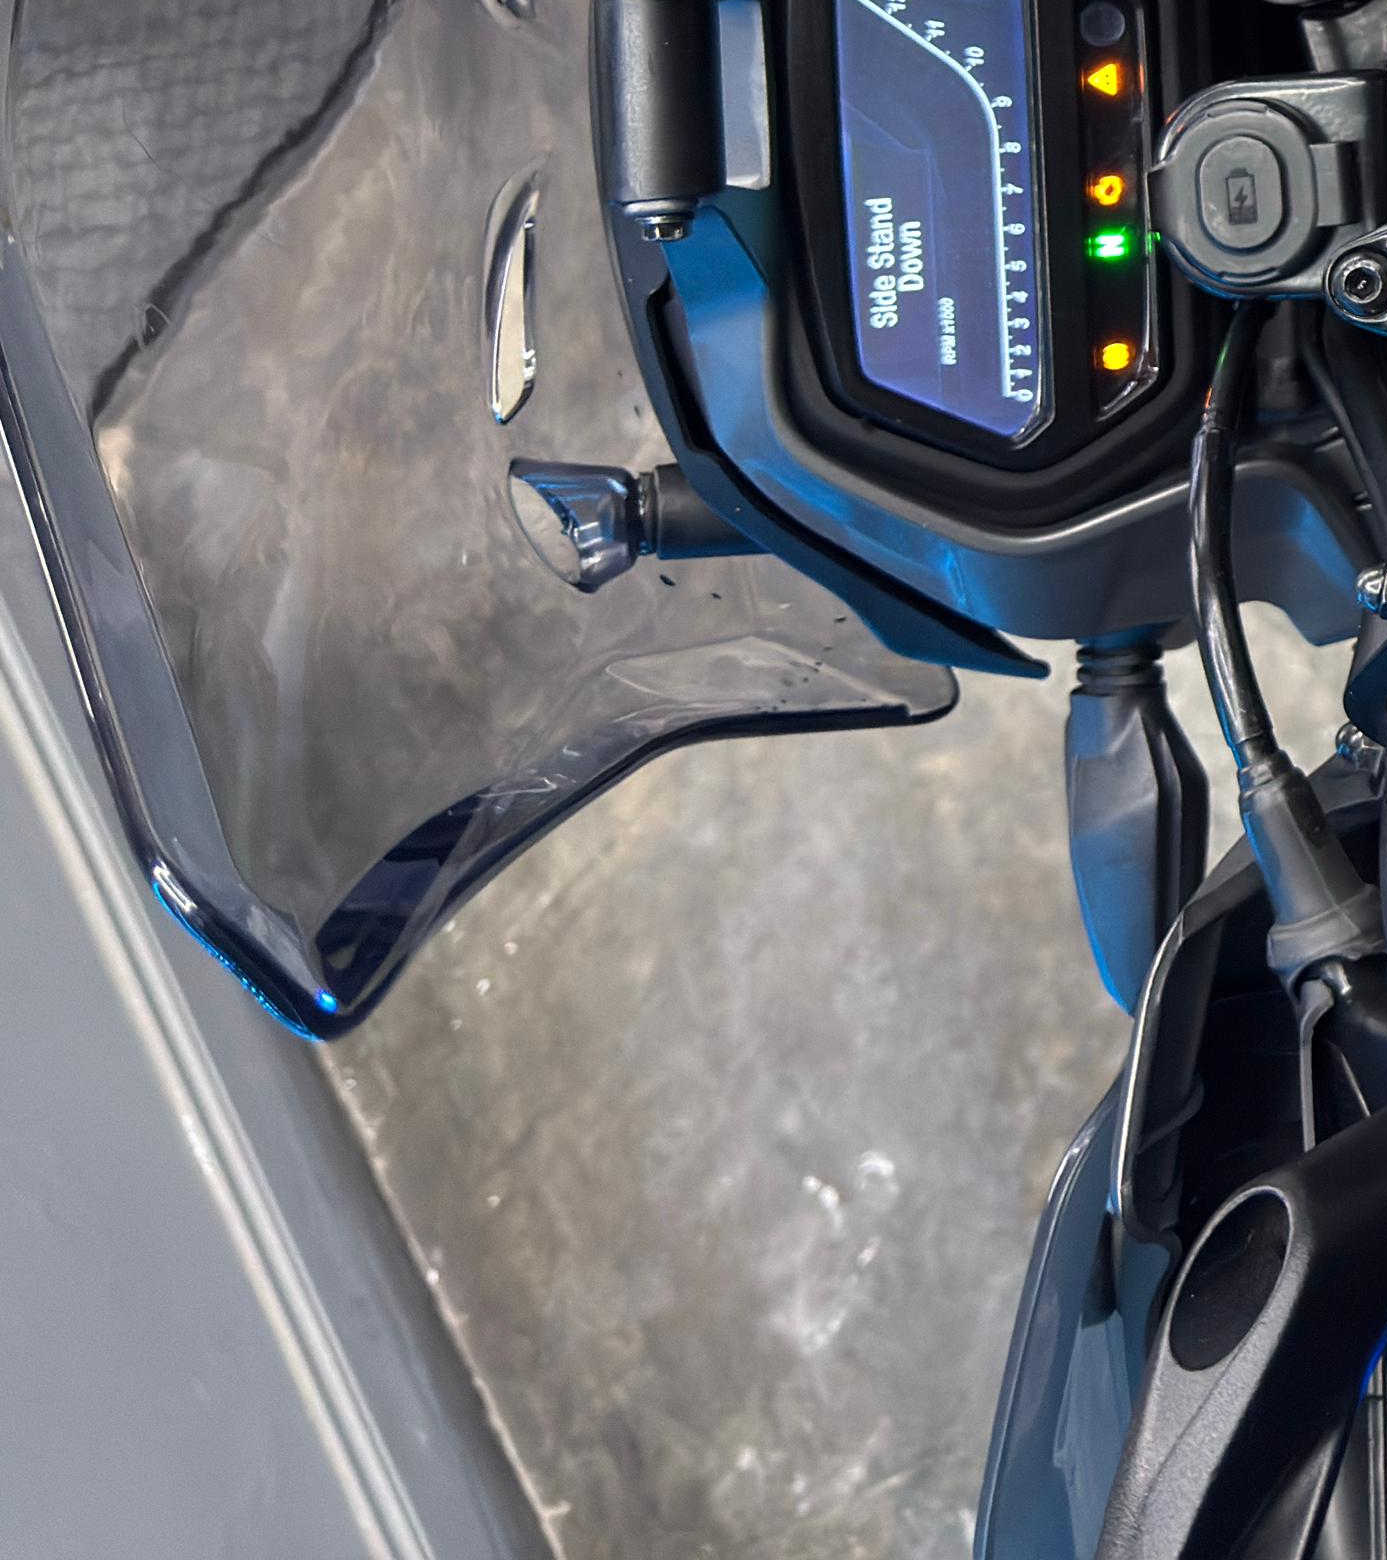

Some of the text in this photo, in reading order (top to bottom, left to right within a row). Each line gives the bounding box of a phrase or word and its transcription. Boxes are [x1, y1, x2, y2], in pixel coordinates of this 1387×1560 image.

[963, 46, 984, 66] 10
[863, 197, 898, 328] Side Stand
[898, 220, 925, 291] Down
